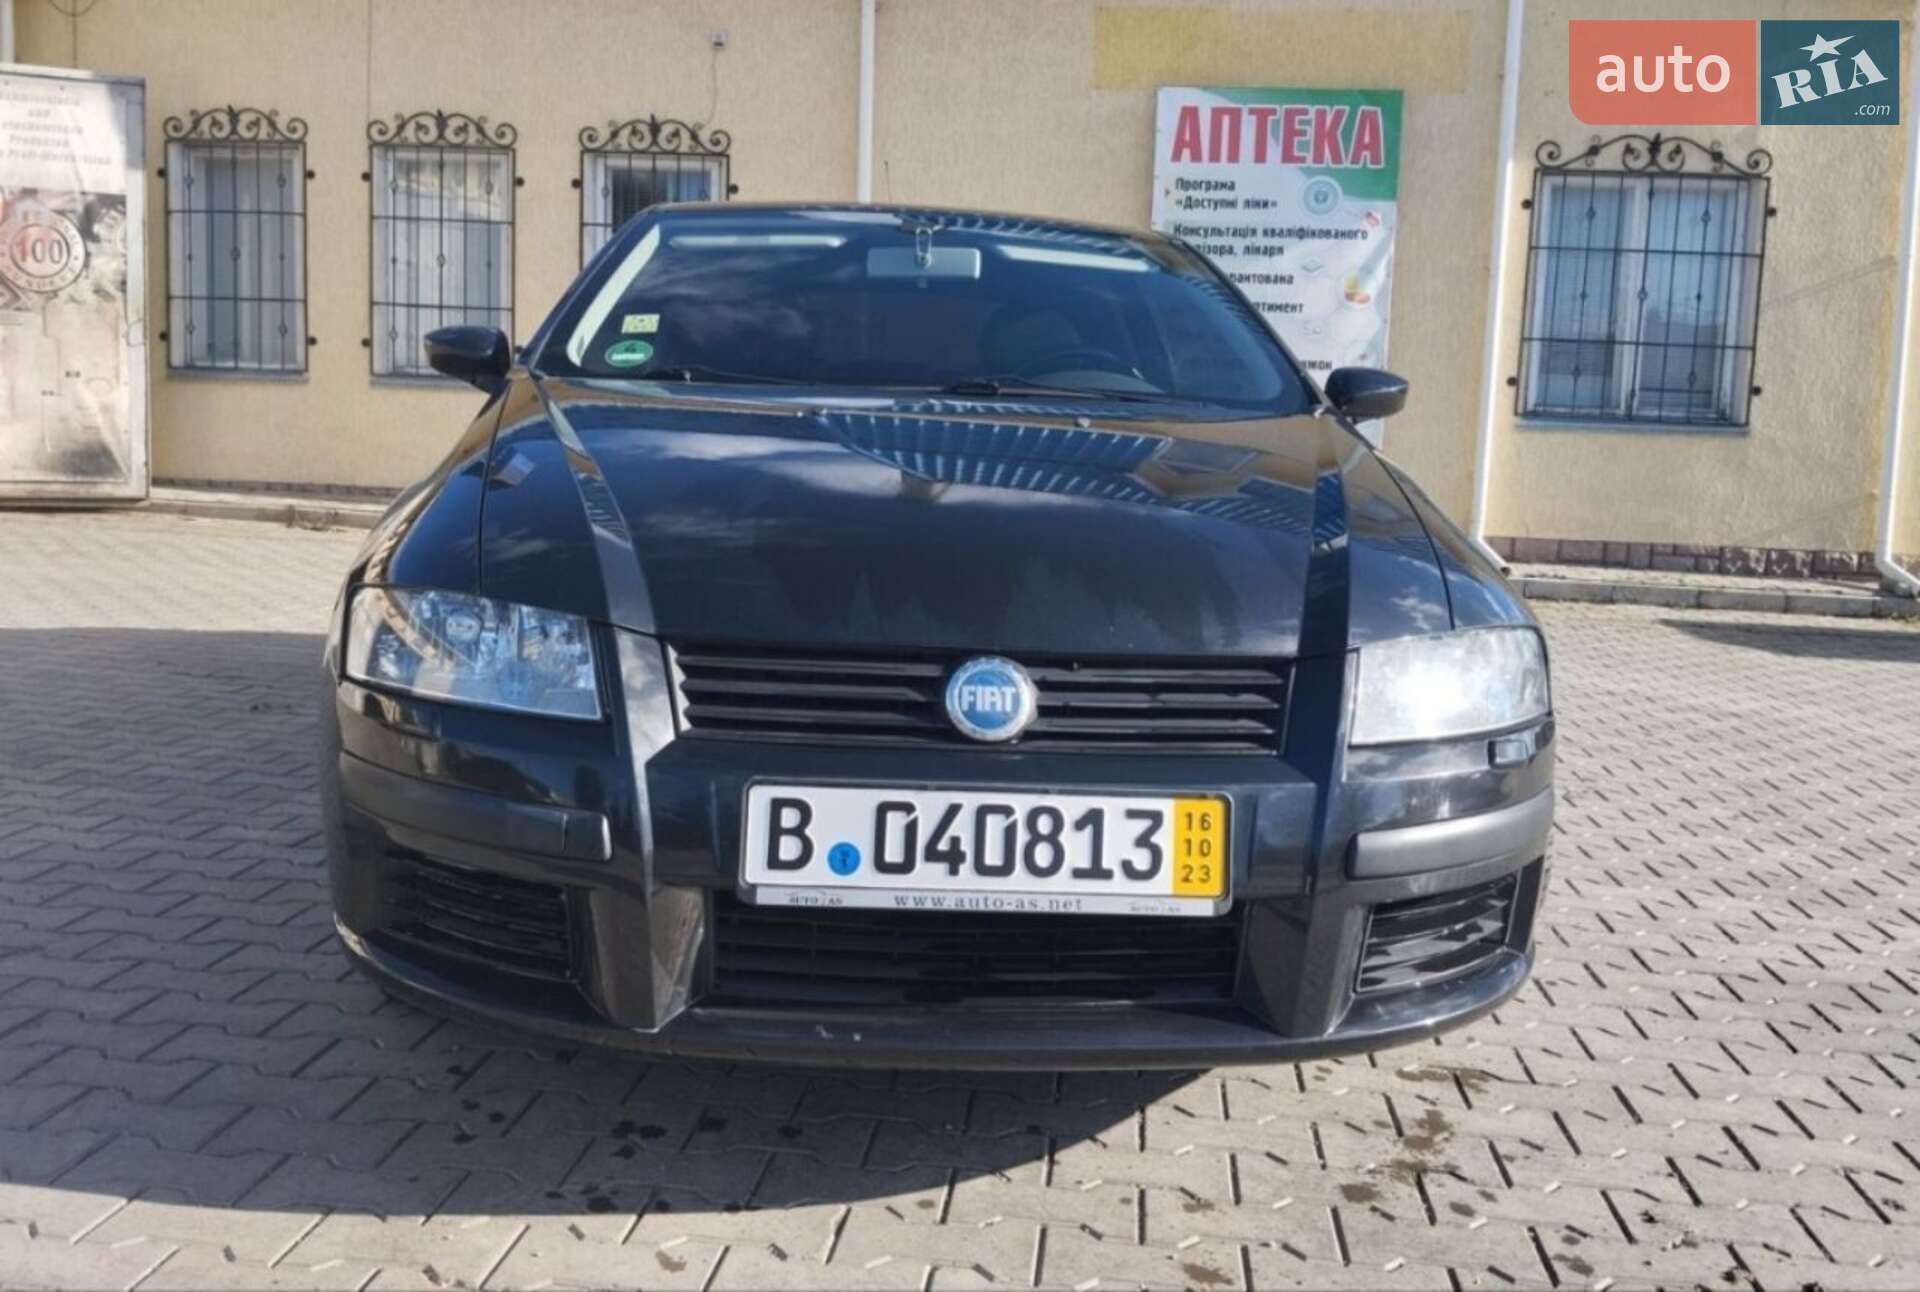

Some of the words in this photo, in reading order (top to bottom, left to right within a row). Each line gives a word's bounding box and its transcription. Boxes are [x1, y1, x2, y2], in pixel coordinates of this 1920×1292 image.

[1170, 105, 1384, 166] АПТЕКА
[1175, 178, 1236, 192] Програма
[1175, 195, 1238, 211] «Доступні
[1243, 196, 1278, 210] ліки»
[1173, 223, 1258, 240] Консультація
[1262, 225, 1369, 241] кваліфікованого
[16, 235, 63, 264] 100
[1243, 242, 1285, 257] лікаря
[961, 685, 1017, 713] FIAT
[1183, 812, 1212, 832] 16
[767, 797, 815, 871] B
[873, 800, 1165, 882] 040813
[1183, 838, 1212, 858] 10
[1181, 864, 1212, 884] 23
[893, 894, 1083, 912] www.auto-as.net
